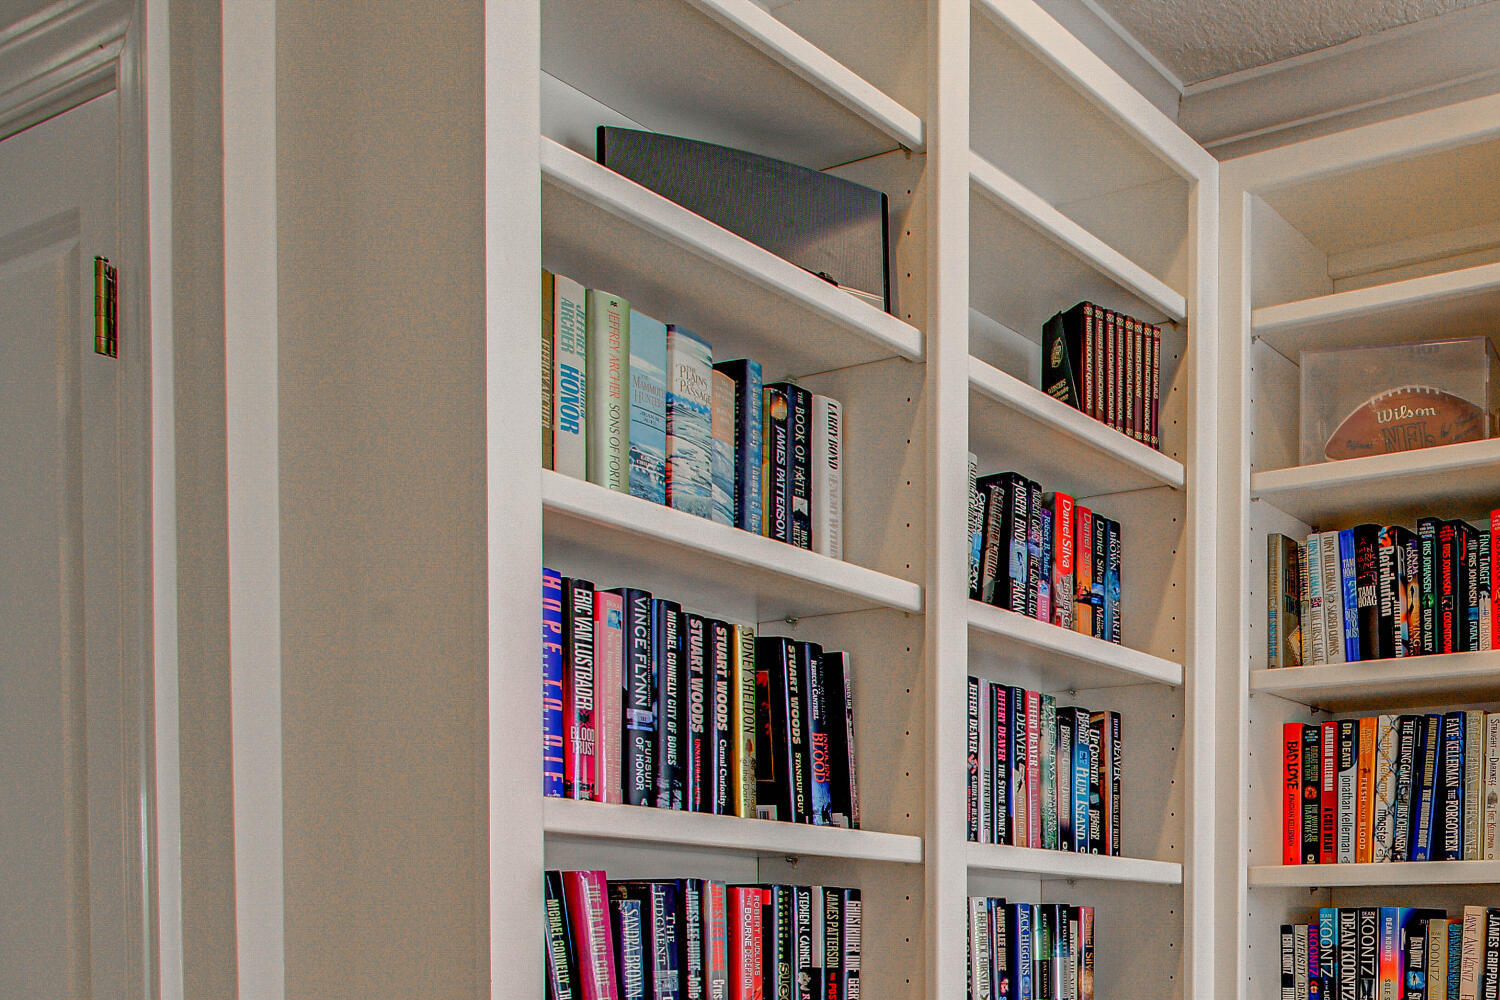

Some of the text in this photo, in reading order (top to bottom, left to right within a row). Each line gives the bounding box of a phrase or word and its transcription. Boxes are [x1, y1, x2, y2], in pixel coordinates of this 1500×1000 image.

[560, 364, 579, 434] HONOR
[609, 310, 620, 453] JEFFREY ARCHER SONS OF
[1376, 405, 1437, 424] Wilson
[775, 425, 786, 539] JAMES PATTERSON
[1062, 500, 1071, 568] Daniel Silva
[1096, 520, 1104, 583] Daniel Silva
[1423, 541, 1432, 593] IRIS JOHANSEN
[573, 588, 594, 712] ERIC VAN LUSTBADER
[634, 597, 647, 706] VINCE FLYNN
[1424, 609, 1432, 651] BLIND ALLEY
[666, 610, 677, 766] MICHAEL CONNELLY CITY OF BONES
[997, 688, 1006, 761] JEFFERY DEAVER
[1016, 713, 1026, 761] DEAVER
[1400, 721, 1414, 784] THE KILLING GAME
[635, 736, 645, 790] OF HONOR
[644, 740, 652, 790] PURSUIT
[998, 780, 1006, 803] STONE
[998, 805, 1006, 836] MONKEY
[1340, 775, 1353, 853] jonathan kellerman
[622, 909, 642, 997] SANDRA BROWN
[653, 890, 666, 966] JUDGMENT
[666, 913, 676, 943] THE
[826, 891, 839, 968] JAMES PATTERSON
[1020, 909, 1030, 975] JACK HIGGINS
[1297, 933, 1306, 977] INTENSITY
[1320, 918, 1333, 978] KOONTZ
[1340, 912, 1356, 1000] DEAN KOONTZ
[1360, 916, 1375, 976] KOONTZ
[1488, 914, 1500, 947] JAMES
